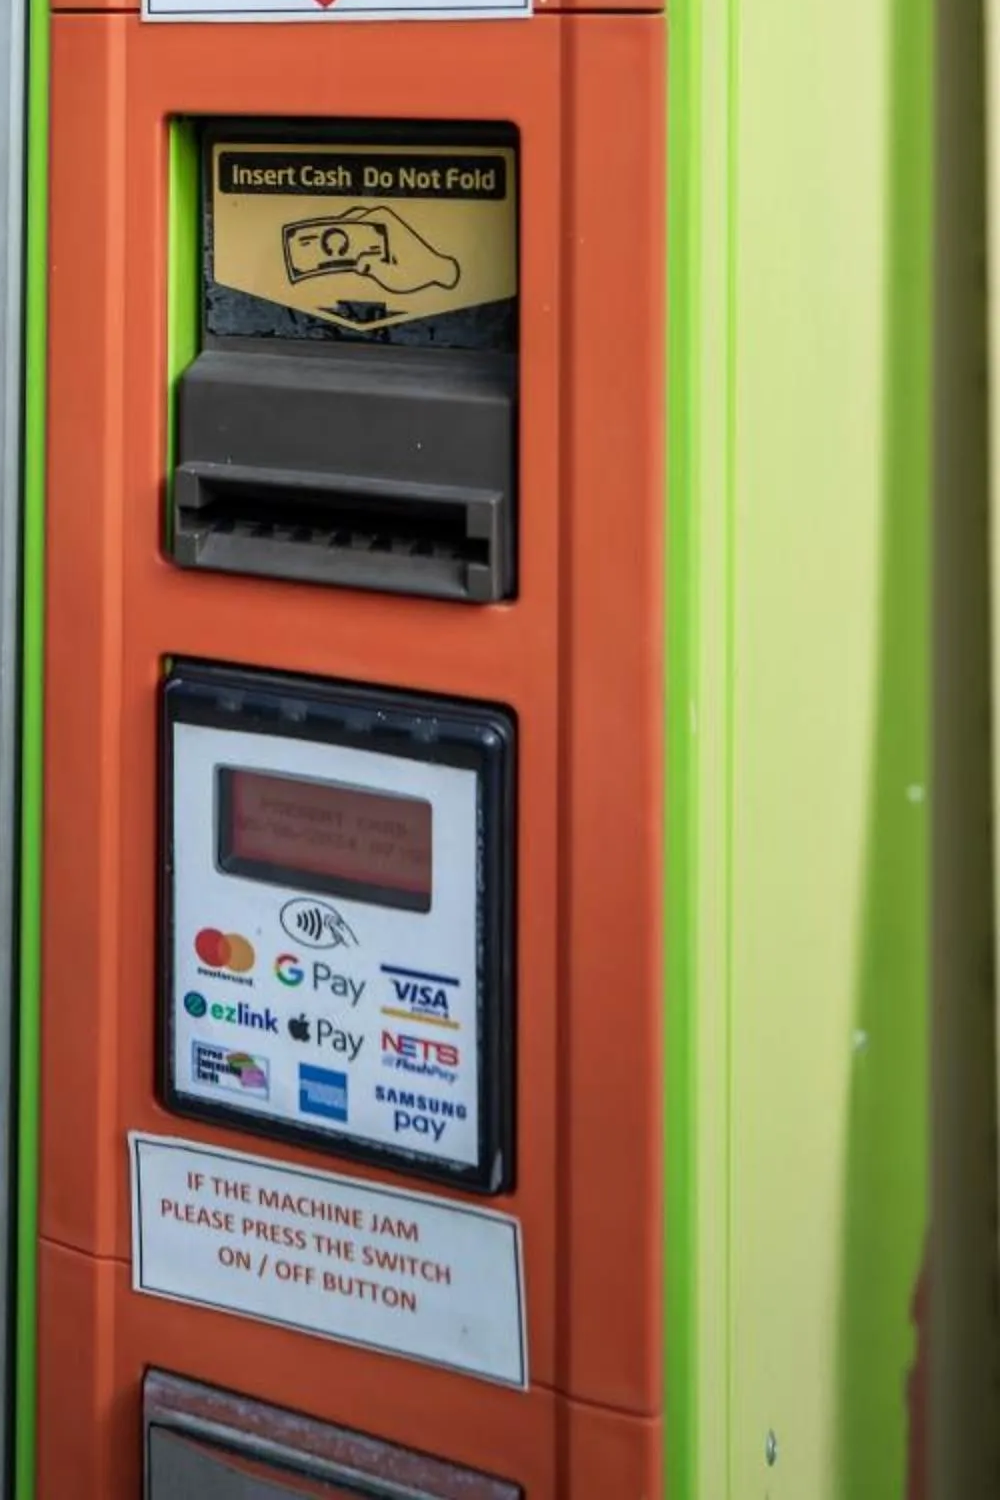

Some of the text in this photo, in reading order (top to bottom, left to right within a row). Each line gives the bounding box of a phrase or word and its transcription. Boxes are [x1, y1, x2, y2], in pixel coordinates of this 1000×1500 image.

[232, 164, 496, 191] Insert Cash Do Not Fold
[313, 960, 367, 1008] Pay
[391, 978, 449, 1010] VISA
[210, 1001, 279, 1034] ezlink
[316, 1018, 365, 1062] Pay
[381, 1029, 459, 1067] NETS
[375, 1085, 467, 1120] SAMSUNG
[394, 1110, 447, 1142] pay
[186, 1171, 419, 1242] IF THE MACHINE JAM
[161, 1199, 452, 1285] PLEASE PRESS THE SWITCH
[218, 1246, 250, 1270] ON
[275, 1260, 316, 1285] OFF
[323, 1272, 417, 1312] BUTTON
